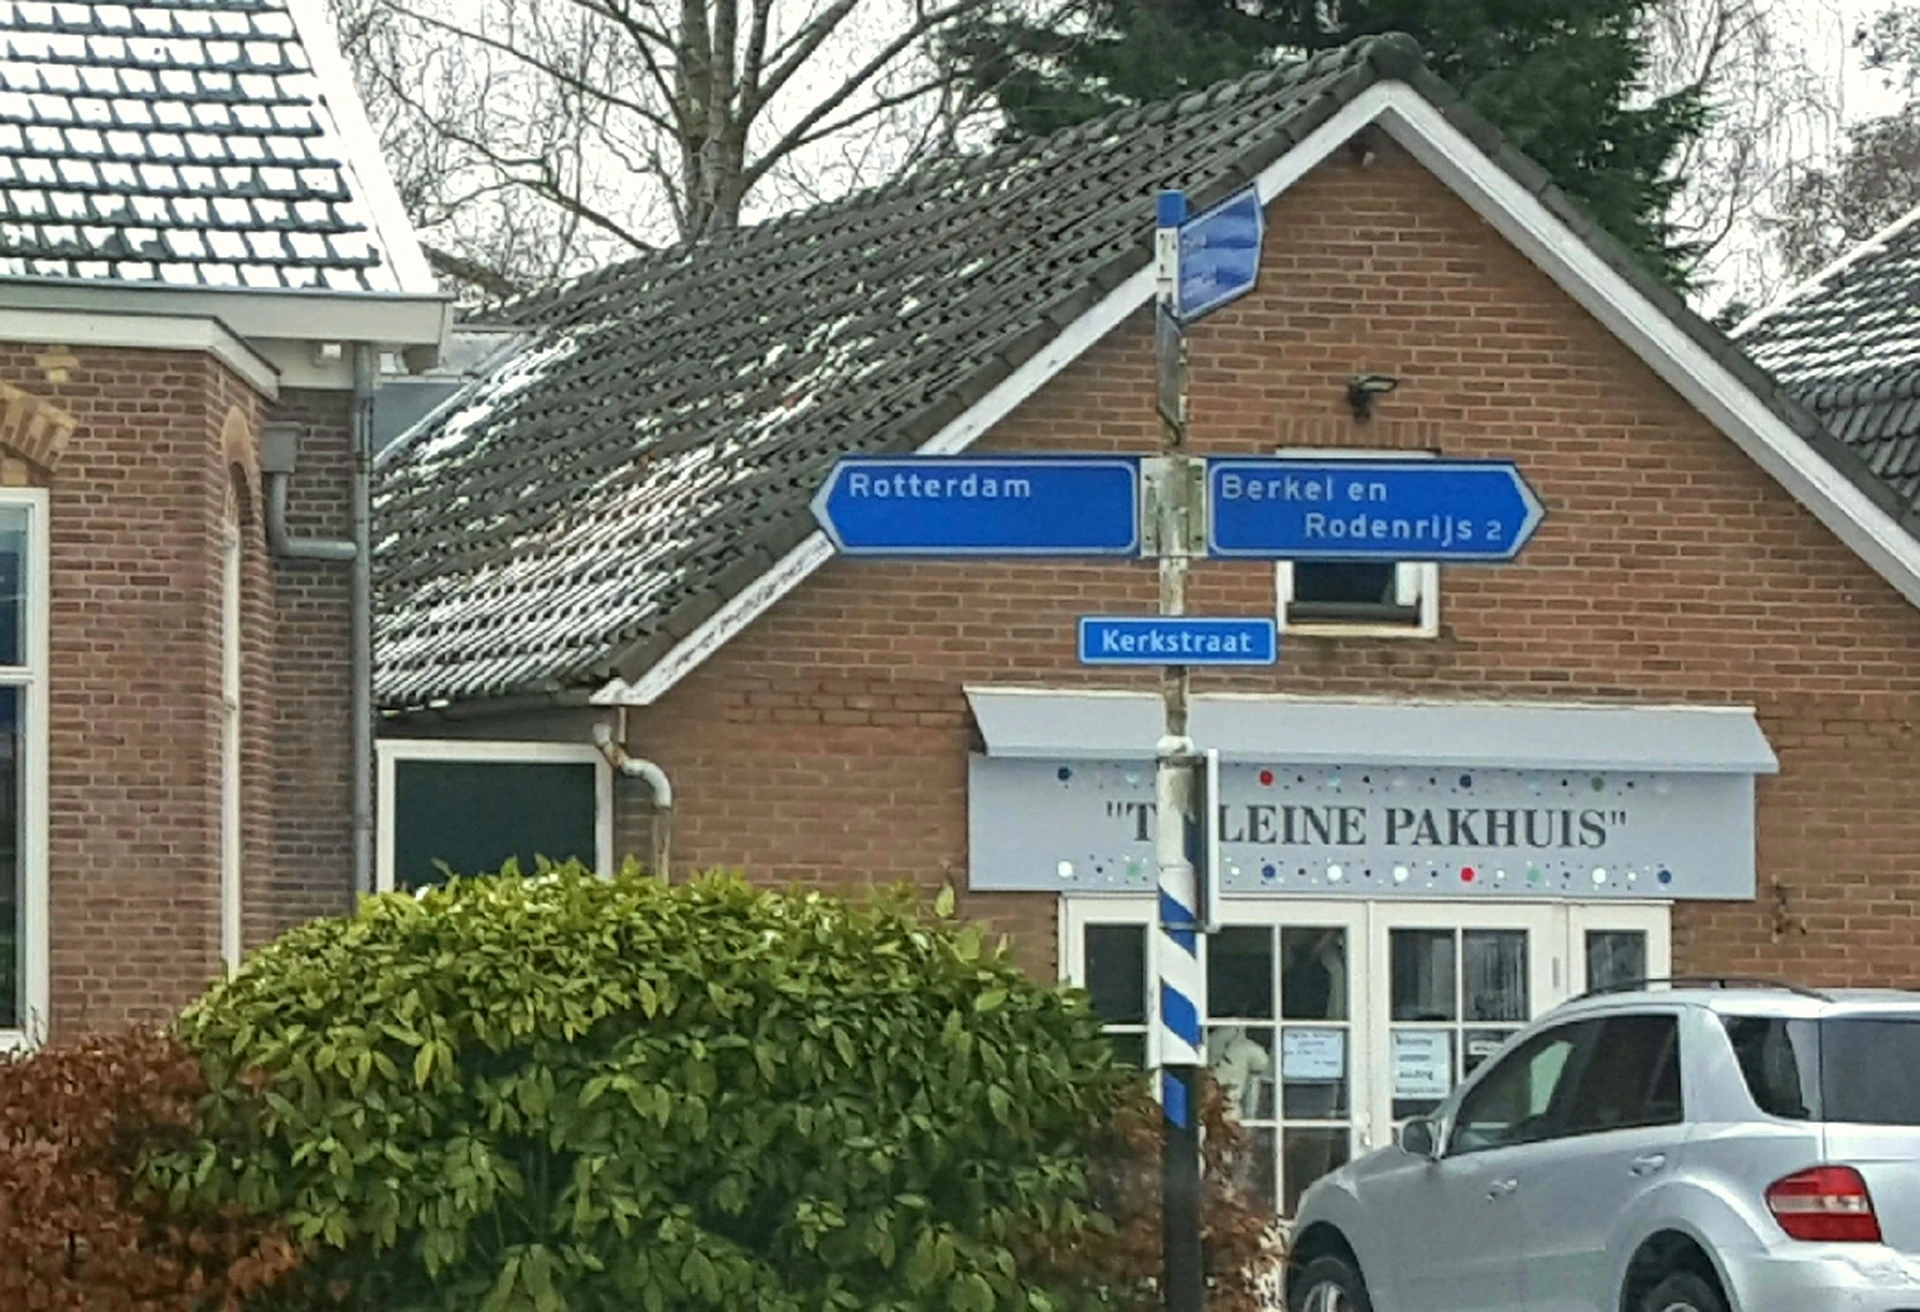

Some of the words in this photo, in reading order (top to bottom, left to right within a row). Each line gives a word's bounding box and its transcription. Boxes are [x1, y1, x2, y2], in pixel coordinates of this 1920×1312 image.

[850, 472, 1031, 498] Rotterdam
[1220, 474, 1333, 500] Berkel
[1347, 482, 1387, 501] en
[1304, 512, 1472, 547] Rodenrijs
[1486, 520, 1502, 540] 2
[1102, 629, 1252, 652] Kerkstraat
[1217, 803, 1367, 845] LEINE
[1384, 807, 1627, 849] PAKHUIS"
